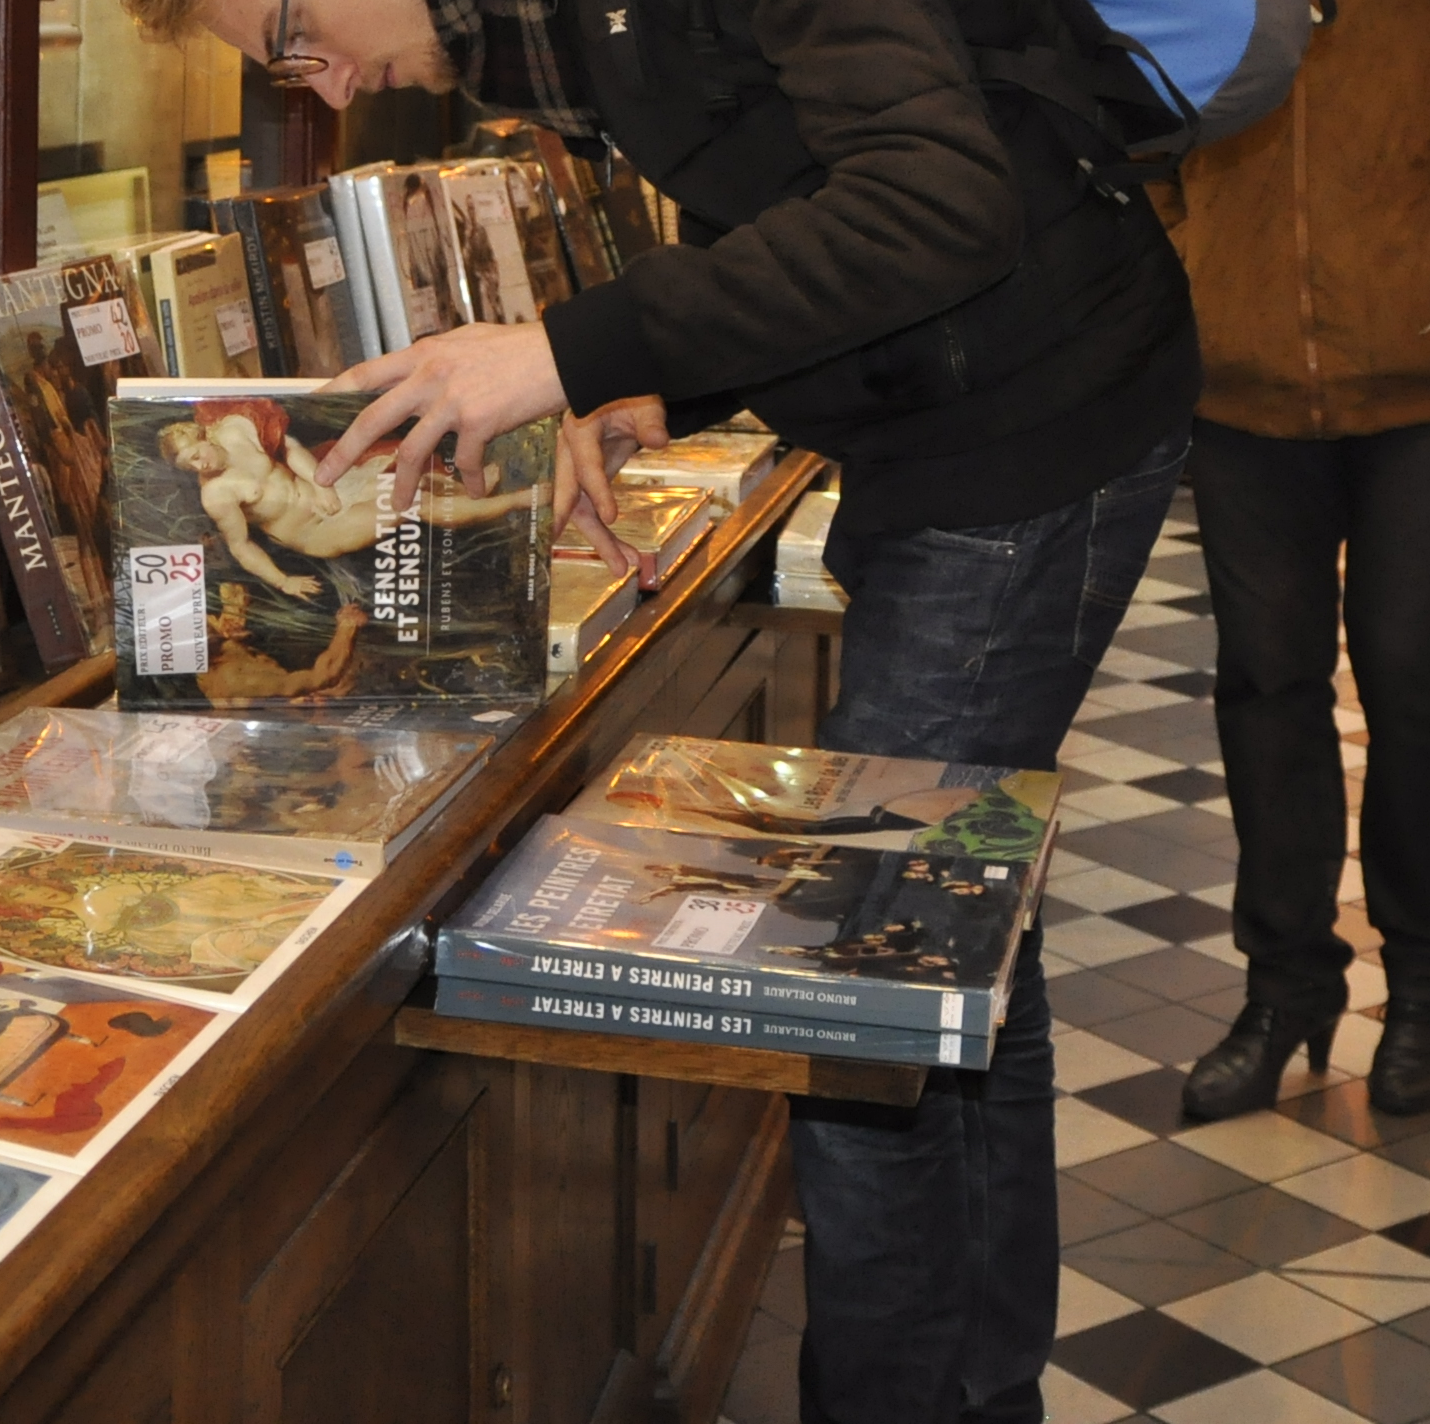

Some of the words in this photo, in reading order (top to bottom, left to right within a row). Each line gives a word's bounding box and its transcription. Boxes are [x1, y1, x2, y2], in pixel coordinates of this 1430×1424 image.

[76, 324, 103, 339] PROMO
[121, 330, 136, 354] 20
[374, 472, 397, 620] SENSATION
[443, 529, 453, 556] SON
[134, 554, 169, 585] 50
[169, 552, 202, 583] 25
[442, 561, 453, 577] ET
[192, 588, 203, 615] PRIX
[440, 581, 452, 632] RUBENS
[398, 613, 419, 643] ET
[158, 616, 175, 672] PROMO
[193, 616, 206, 672] NOUVEAU
[527, 845, 602, 911] PEINTRES
[568, 874, 636, 931] ETRETAT
[504, 912, 552, 935] LES
[681, 927, 709, 949] PROMO
[530, 954, 606, 979] ETRETAT
[611, 965, 623, 982] A
[628, 966, 715, 993] PEINTRES
[721, 978, 753, 996] LES
[763, 985, 815, 1002] DELARUE
[816, 991, 858, 1006] BRUNO
[530, 995, 606, 1019] ETRETAT
[611, 1005, 623, 1020] A
[628, 1006, 715, 1031] PEINTRES
[721, 1016, 753, 1034] LES
[763, 1024, 815, 1039] DELARUE
[816, 1028, 858, 1042] BRUNO
